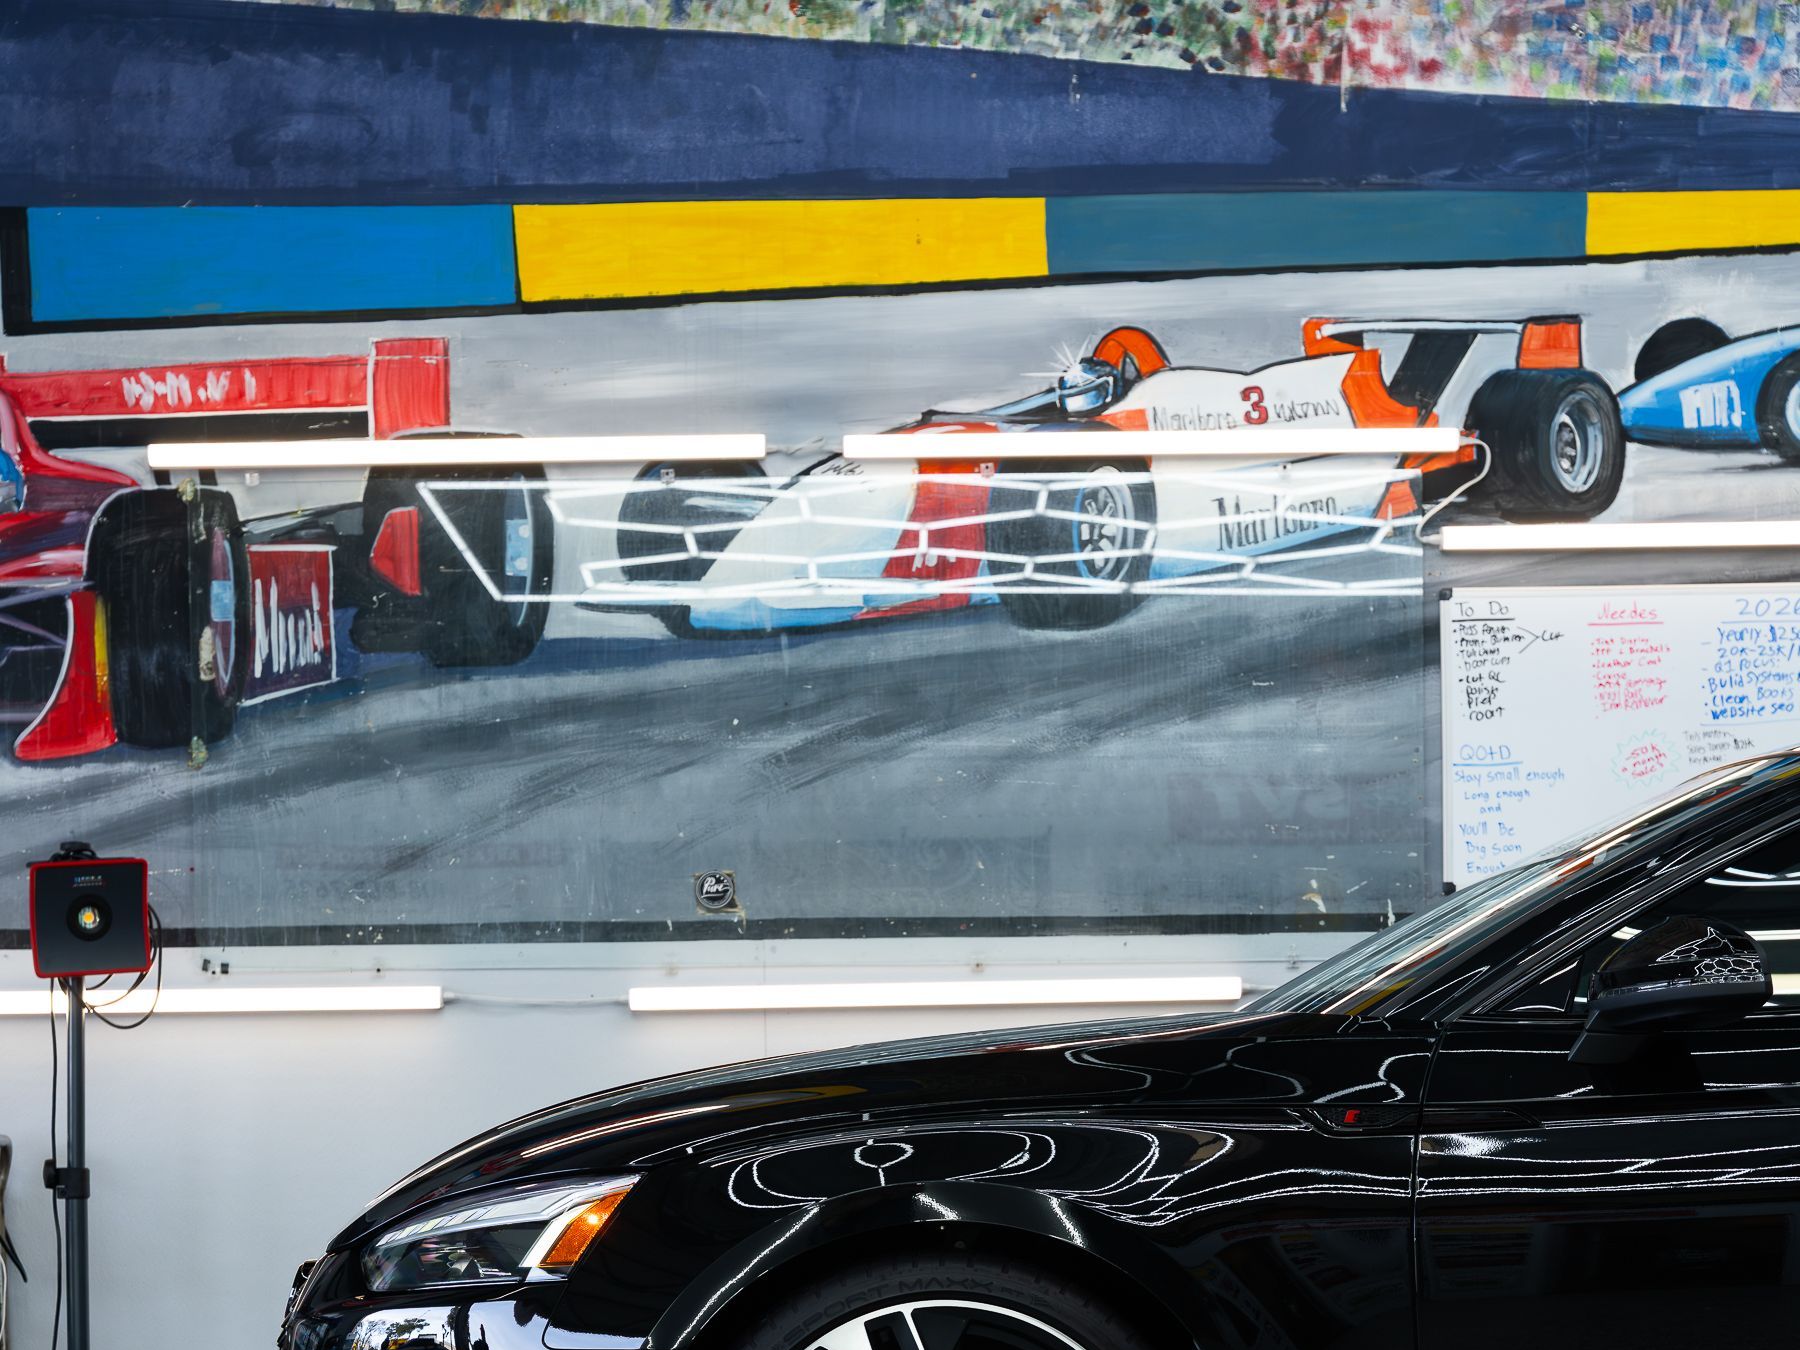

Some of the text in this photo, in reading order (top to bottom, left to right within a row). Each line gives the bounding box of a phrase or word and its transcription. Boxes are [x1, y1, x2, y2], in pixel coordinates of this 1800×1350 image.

[1240, 385, 1269, 425] 3
[1211, 494, 1338, 552] Marlboro
[1455, 600, 1509, 617] To Do
[1455, 767, 1565, 787] Stay small enough
[1464, 789, 1530, 802] Long enough
[1480, 803, 1501, 814] and
[1498, 822, 1515, 836] Be
[898, 1276, 994, 1293] MAXX
